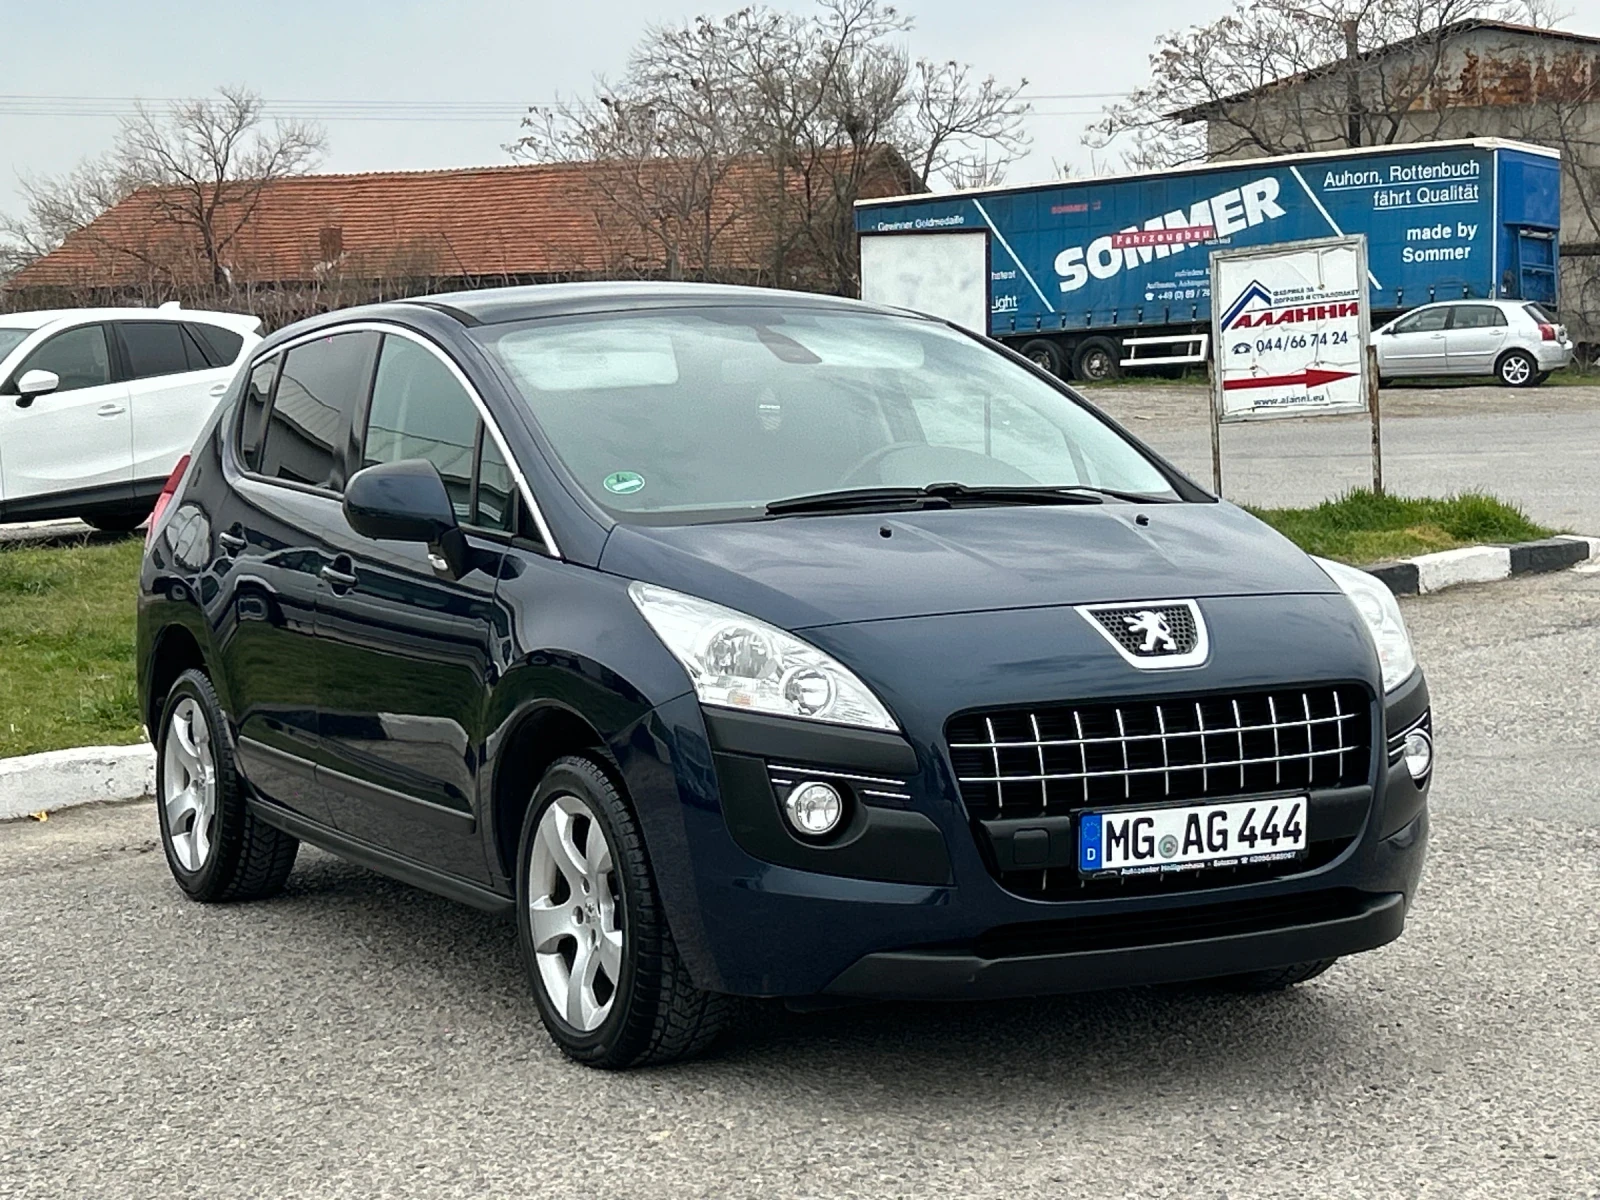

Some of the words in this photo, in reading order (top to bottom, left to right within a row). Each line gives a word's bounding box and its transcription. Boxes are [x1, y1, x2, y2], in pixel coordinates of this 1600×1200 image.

[1323, 170, 1383, 187] Auhorn,
[1390, 160, 1480, 181] Rottenbuch
[1373, 189, 1411, 207] fährt
[1417, 184, 1479, 203] Qualität
[1054, 177, 1286, 293] SOMMER
[1116, 229, 1211, 246] Fahrzeugbau
[1406, 223, 1452, 241] made
[1457, 222, 1478, 240] by
[1402, 245, 1471, 263] Sommer
[1231, 302, 1359, 330] АЛАННИ
[1256, 335, 1306, 352] 044/66
[1310, 333, 1328, 346] 74
[1331, 331, 1348, 345] 24
[1105, 817, 1155, 862] MG
[1182, 810, 1228, 855] AG
[1237, 803, 1302, 849] 444
[1086, 847, 1096, 861] D
